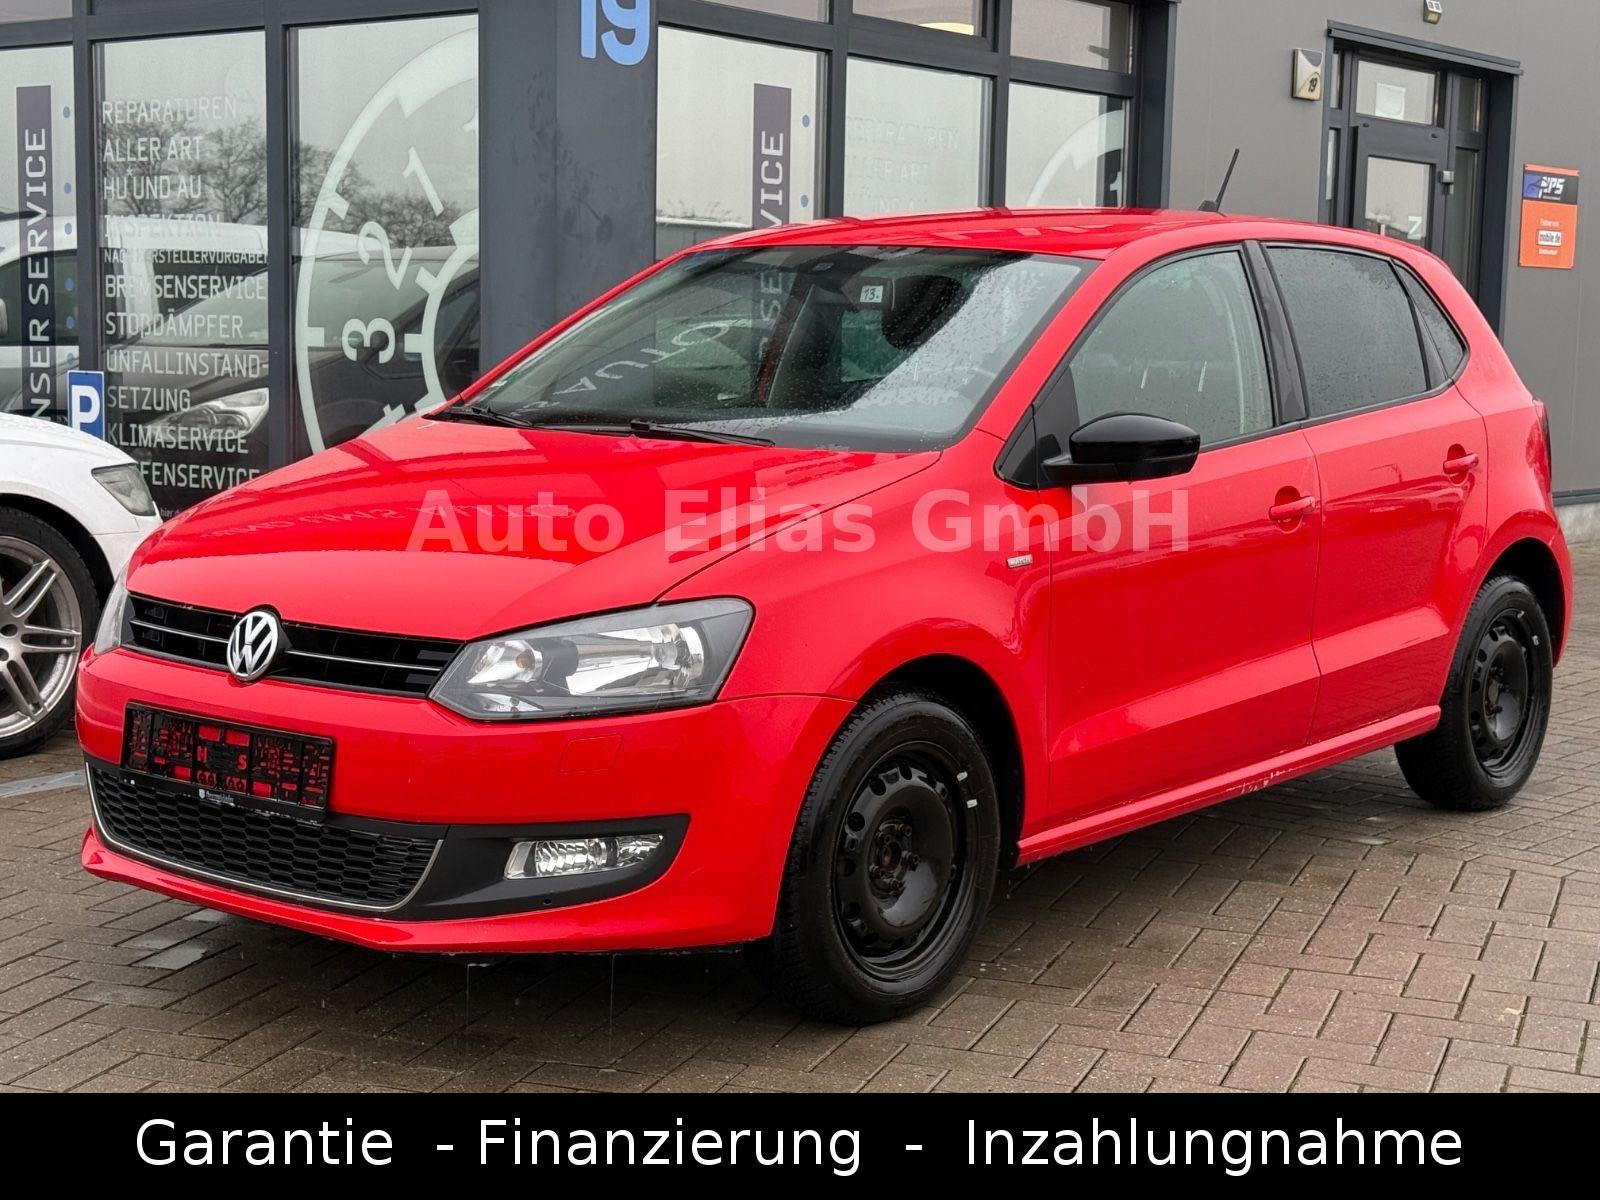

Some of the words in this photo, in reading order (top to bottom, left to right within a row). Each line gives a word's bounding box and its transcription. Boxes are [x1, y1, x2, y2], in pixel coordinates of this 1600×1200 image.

[103, 96, 236, 124] REPARATUREN
[103, 138, 161, 162] ALLER
[167, 136, 203, 160] ART
[133, 176, 171, 199] UND
[177, 175, 202, 199] AU
[25, 128, 49, 305] SERVICE
[30, 317, 51, 417] NSER
[106, 349, 268, 378] UNFALLINSTAND-
[71, 385, 101, 432] P
[107, 385, 191, 412] SETZUNG
[107, 423, 249, 454] KLIMASERVICE
